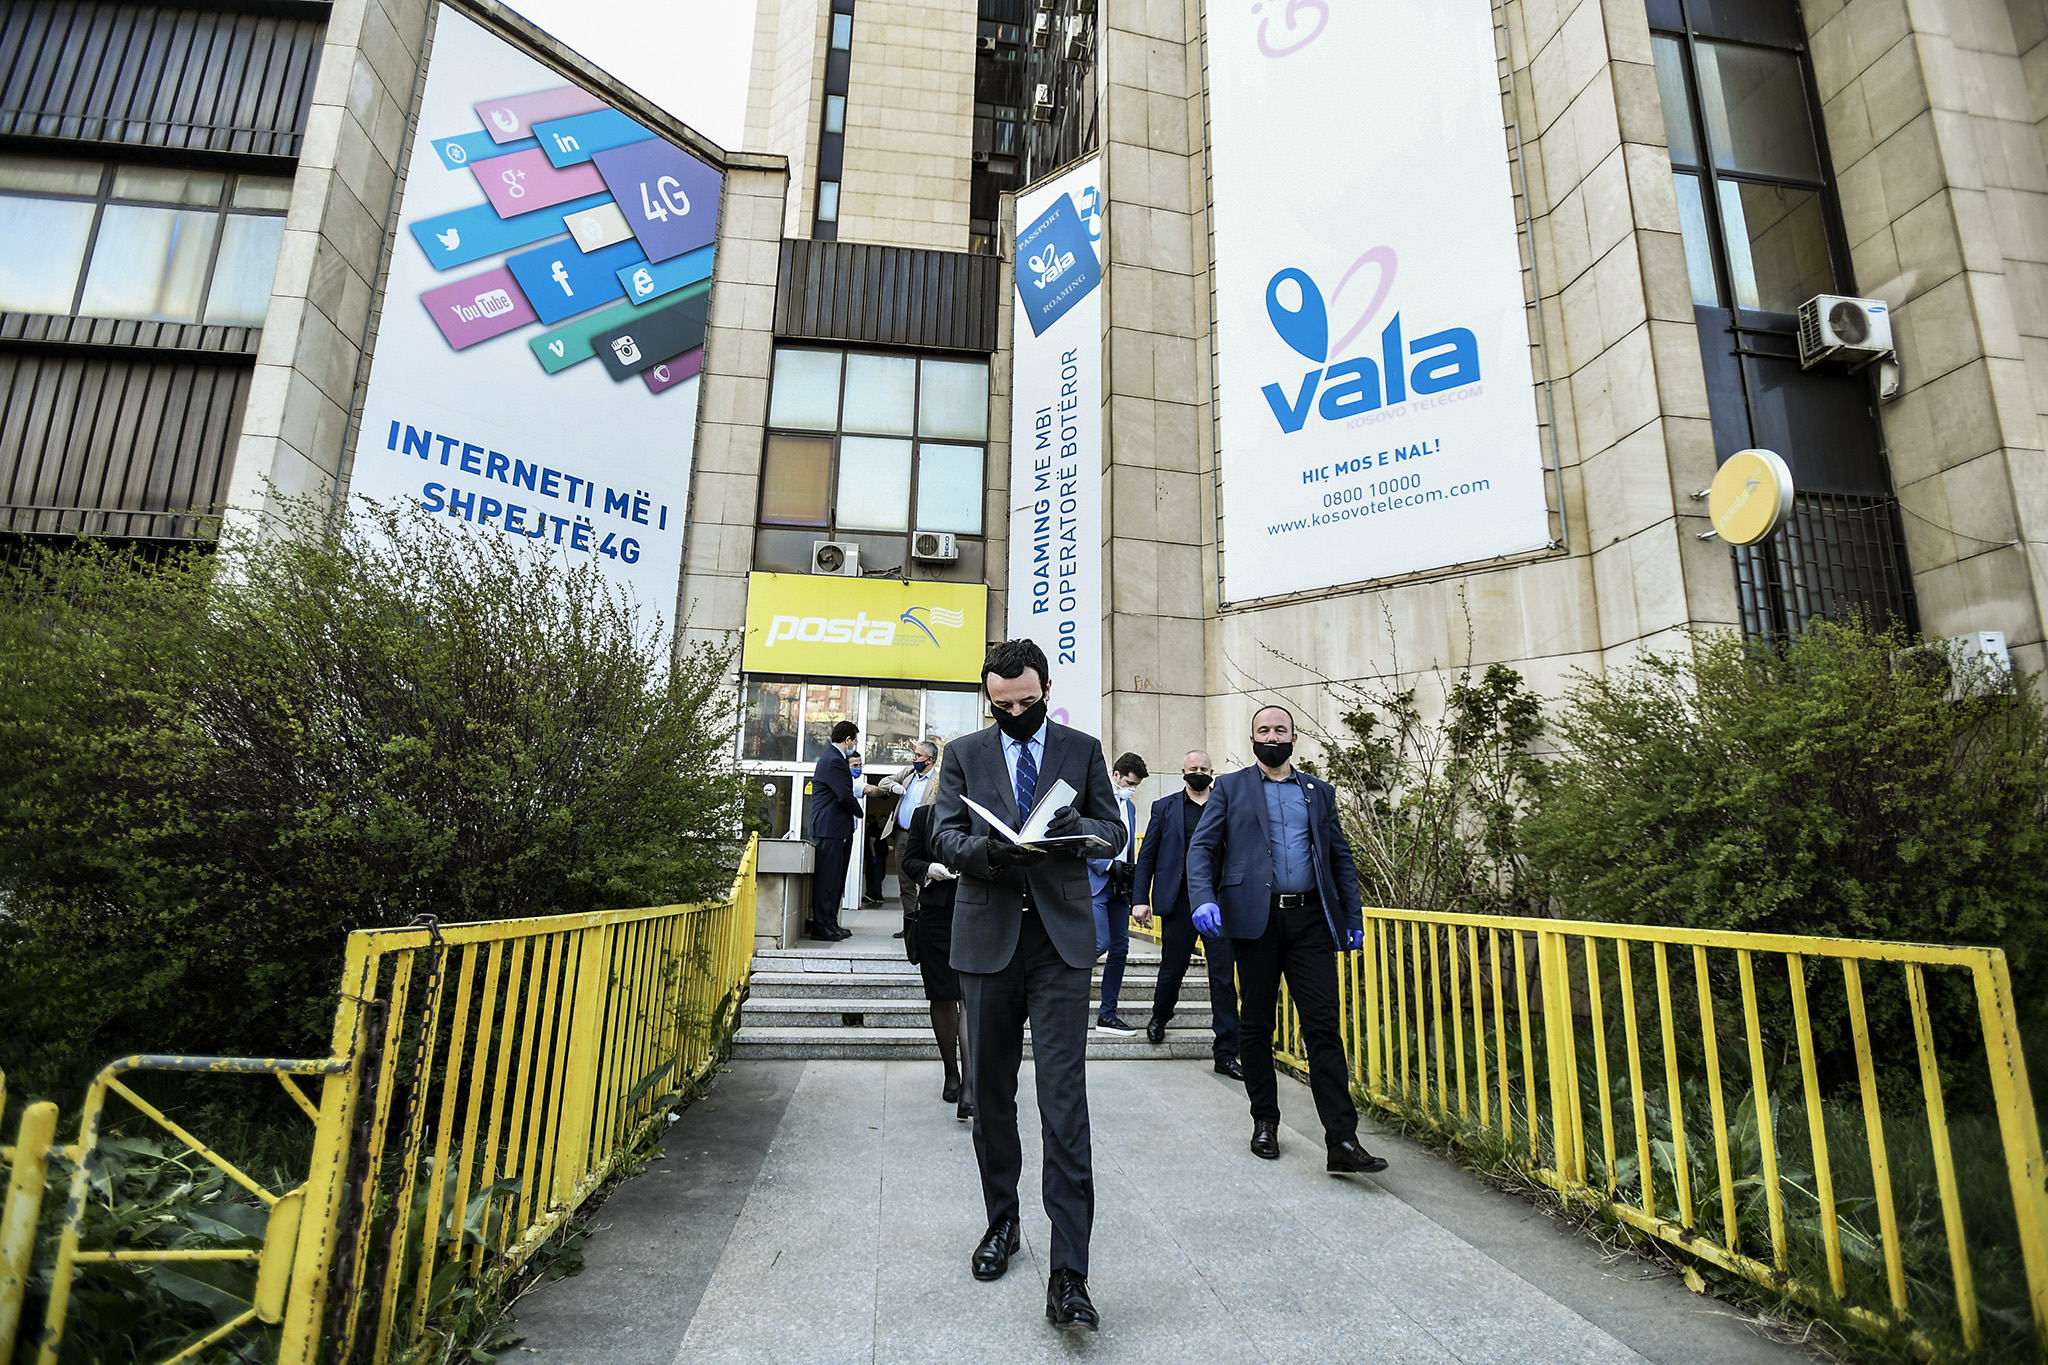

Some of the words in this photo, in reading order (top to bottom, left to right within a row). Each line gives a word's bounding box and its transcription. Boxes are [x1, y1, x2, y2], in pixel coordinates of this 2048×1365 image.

[552, 132, 580, 154] in
[640, 175, 691, 223] 4G
[1018, 209, 1061, 251] PASSPORT
[551, 260, 574, 296] f
[1033, 250, 1077, 290] vala
[1042, 274, 1086, 313] ROAMING
[1261, 310, 1481, 434] vala
[1057, 348, 1078, 459] BOTËROR
[1346, 406, 1407, 431] KOSOVO
[1411, 385, 1484, 413] TELECOM
[1036, 406, 1051, 449] MBI
[387, 420, 594, 508] INTERNETI
[603, 488, 652, 526] MË
[659, 504, 668, 530] I
[1034, 456, 1051, 491] ME
[1302, 466, 1330, 484] HIÇ
[1335, 456, 1372, 477] MOS
[1378, 451, 1388, 466] E
[1395, 438, 1441, 463] NAL!
[1267, 477, 1490, 536] www.kosovotelecom.com
[1323, 486, 1363, 508] 0800
[1369, 473, 1421, 497] 10000
[420, 481, 592, 552] SHPEJTË
[600, 532, 641, 564] 4G
[1056, 464, 1077, 612] OPERATORË
[1033, 499, 1049, 614] ROAMING
[765, 612, 896, 647] posta
[1058, 620, 1076, 665] 200
